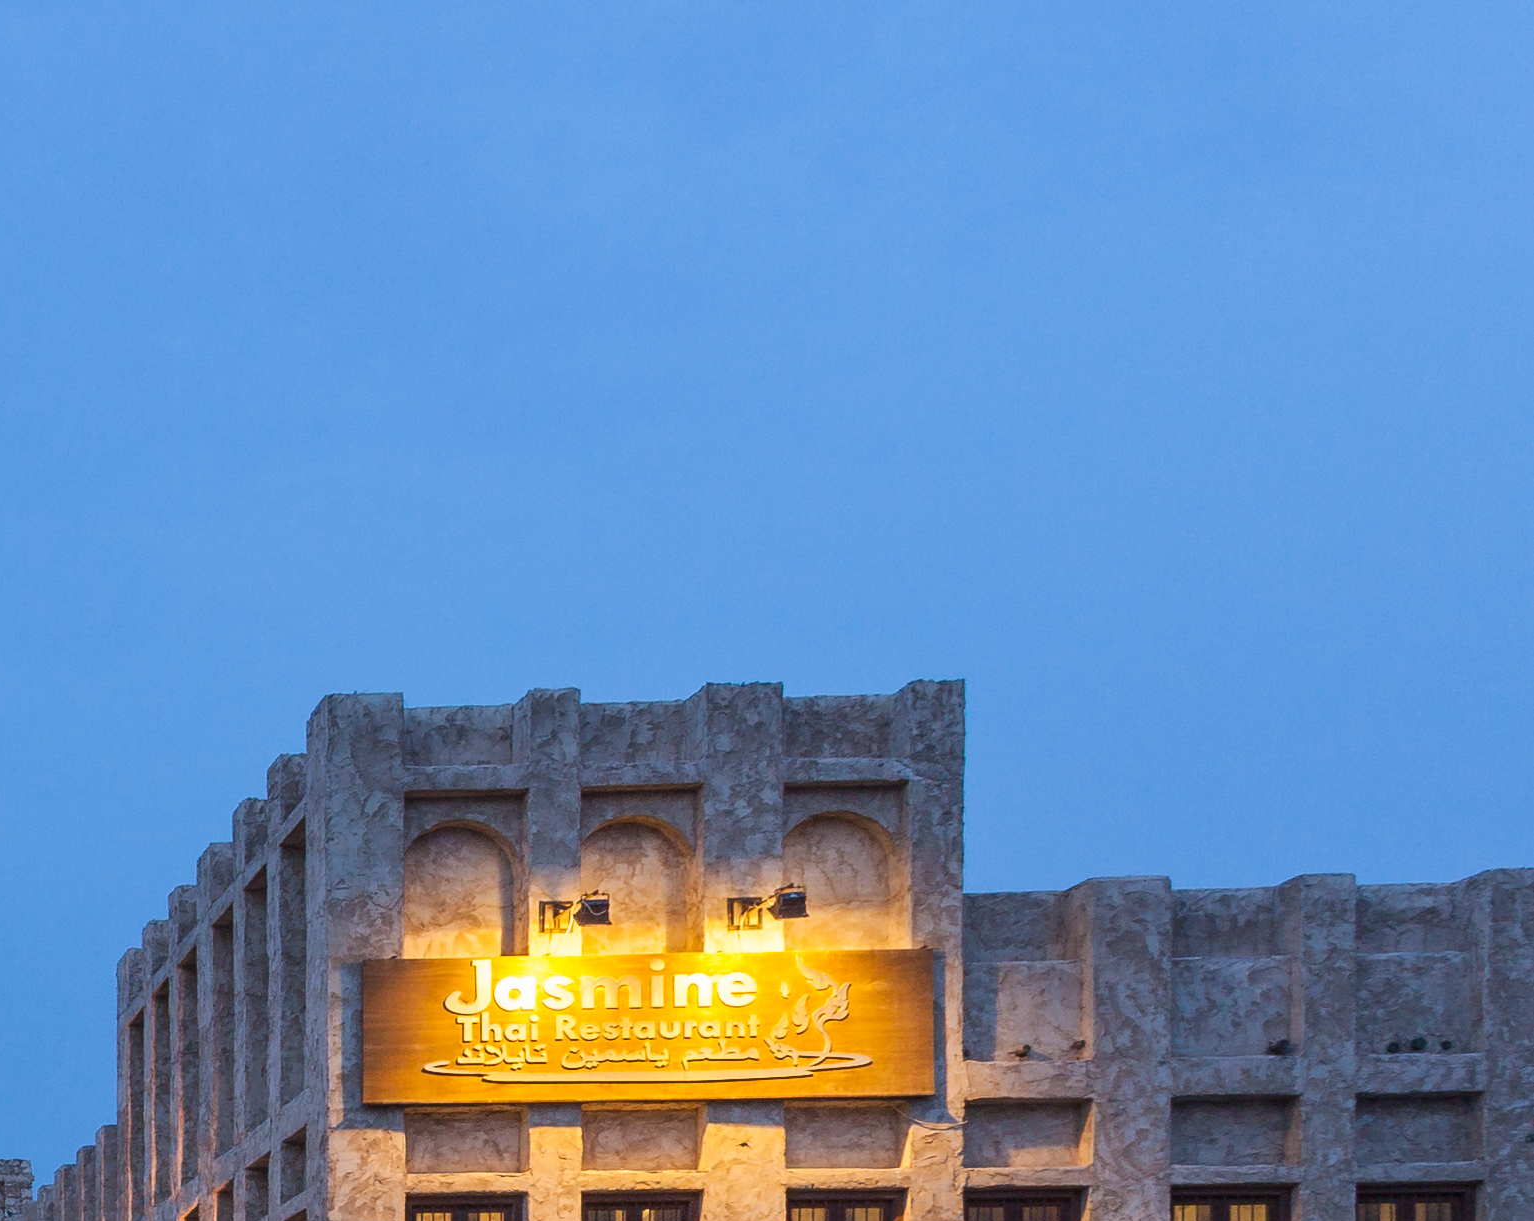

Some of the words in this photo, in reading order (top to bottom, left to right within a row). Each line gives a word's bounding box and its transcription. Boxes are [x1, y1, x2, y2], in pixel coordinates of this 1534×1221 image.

[443, 959, 758, 1015] Jasmine
[455, 1012, 540, 1043] Thai
[554, 1014, 760, 1041] Restaurant
[455, 1043, 548, 1070] تايلاند
[561, 1042, 670, 1070] ياسمين
[682, 1040, 761, 1070] مطعم
